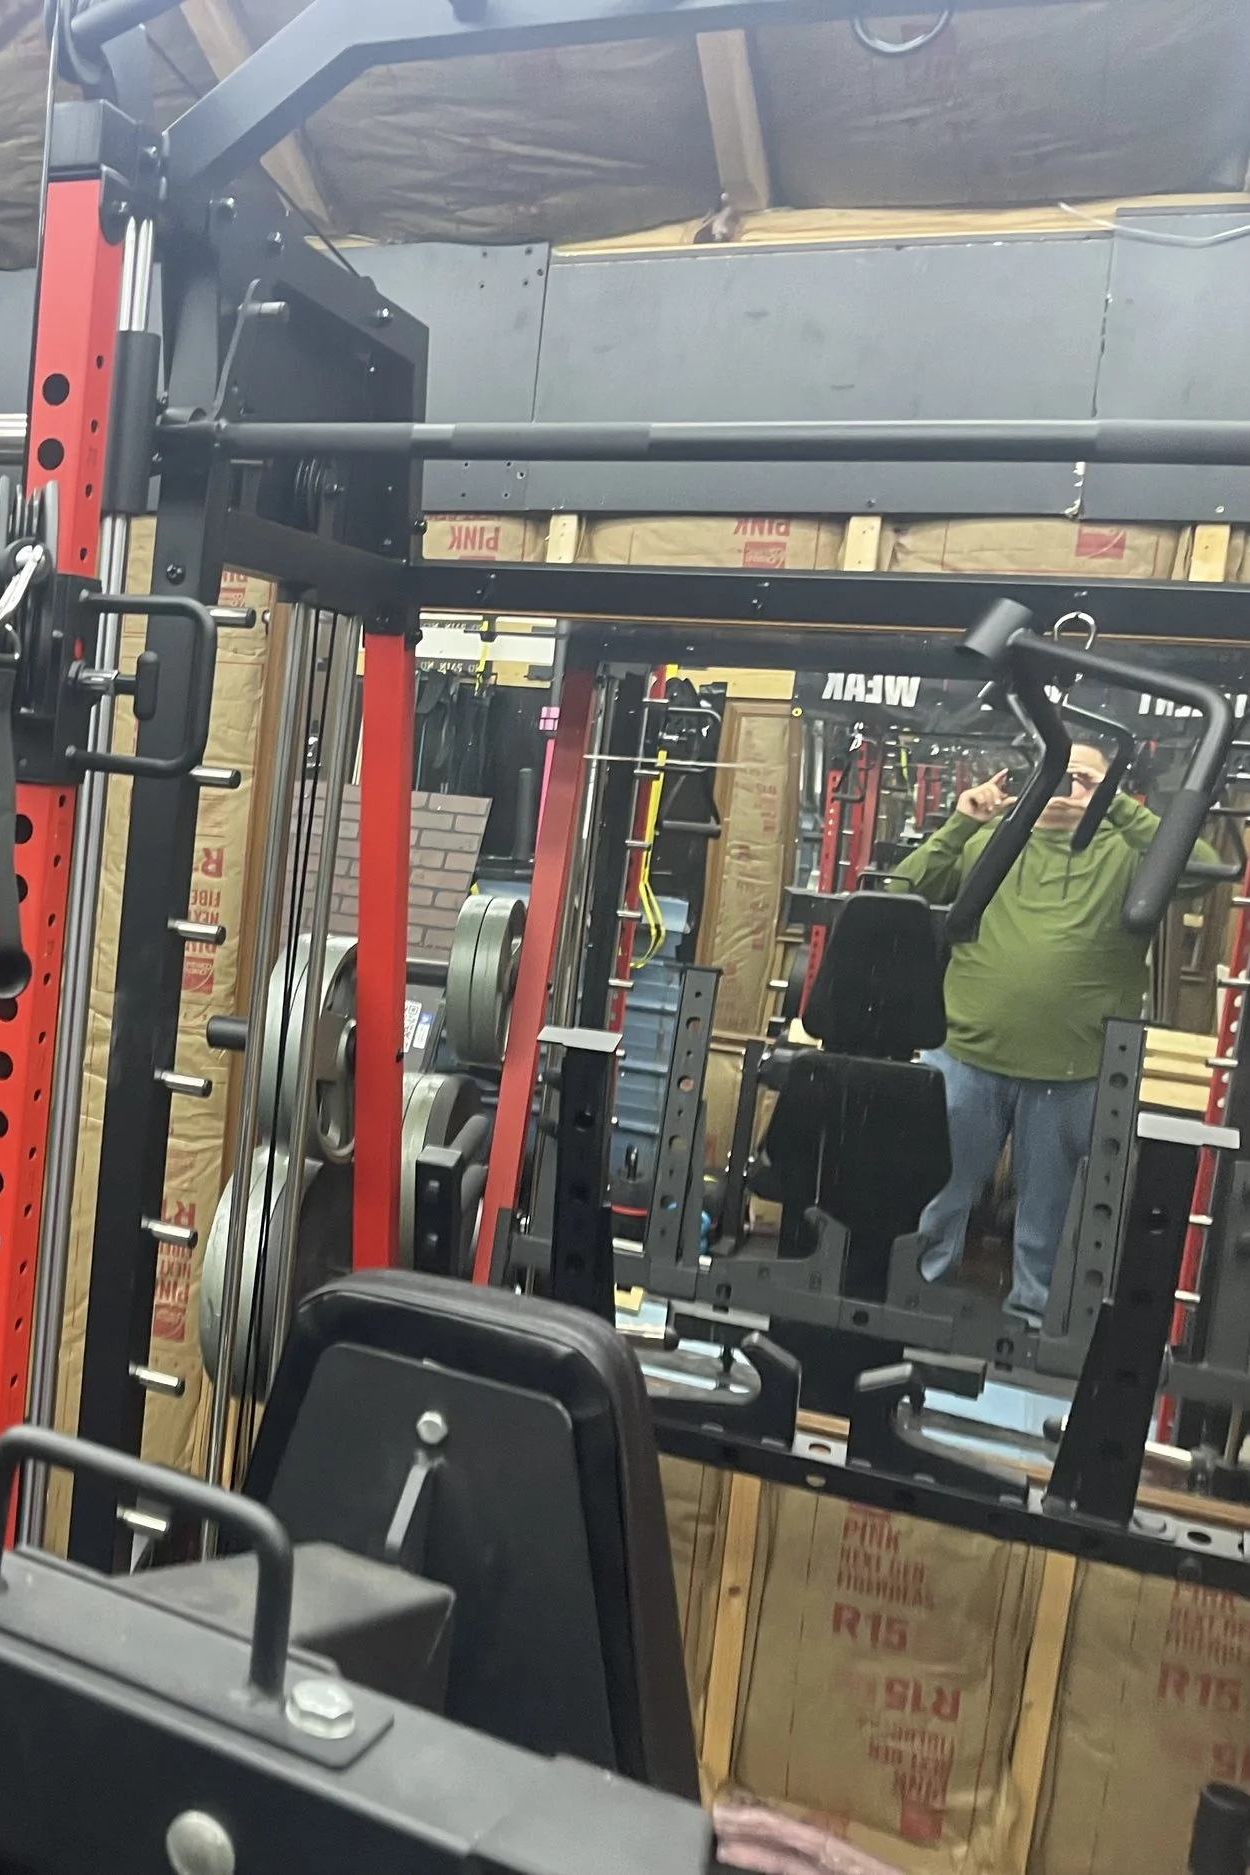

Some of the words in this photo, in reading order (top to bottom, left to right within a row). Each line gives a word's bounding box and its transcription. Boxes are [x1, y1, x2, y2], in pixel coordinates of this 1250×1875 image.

[448, 526, 501, 551] PINK
[156, 1279, 191, 1304] PIN
[832, 1602, 908, 1652] R15
